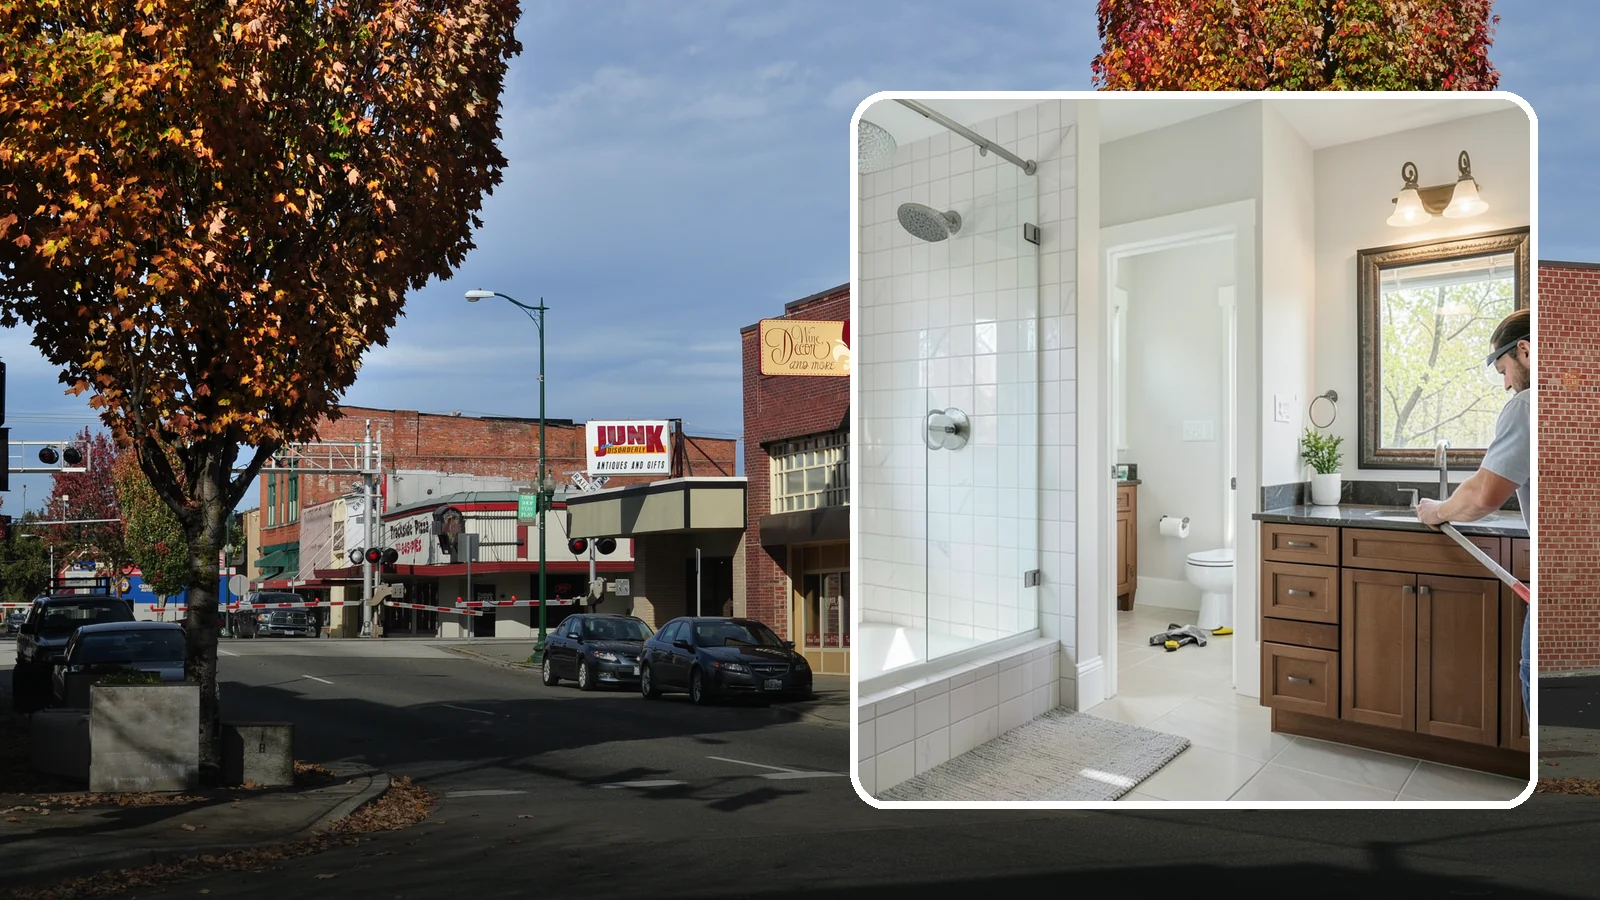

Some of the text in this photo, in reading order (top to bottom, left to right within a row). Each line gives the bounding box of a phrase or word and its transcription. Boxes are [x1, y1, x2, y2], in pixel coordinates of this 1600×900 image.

[765, 328, 831, 365] Decor
[596, 425, 664, 457] JUNK
[607, 446, 645, 454] DISORDERLY
[597, 460, 665, 470] ANTIQUES AND GIFTS
[415, 519, 429, 535] Pizza
